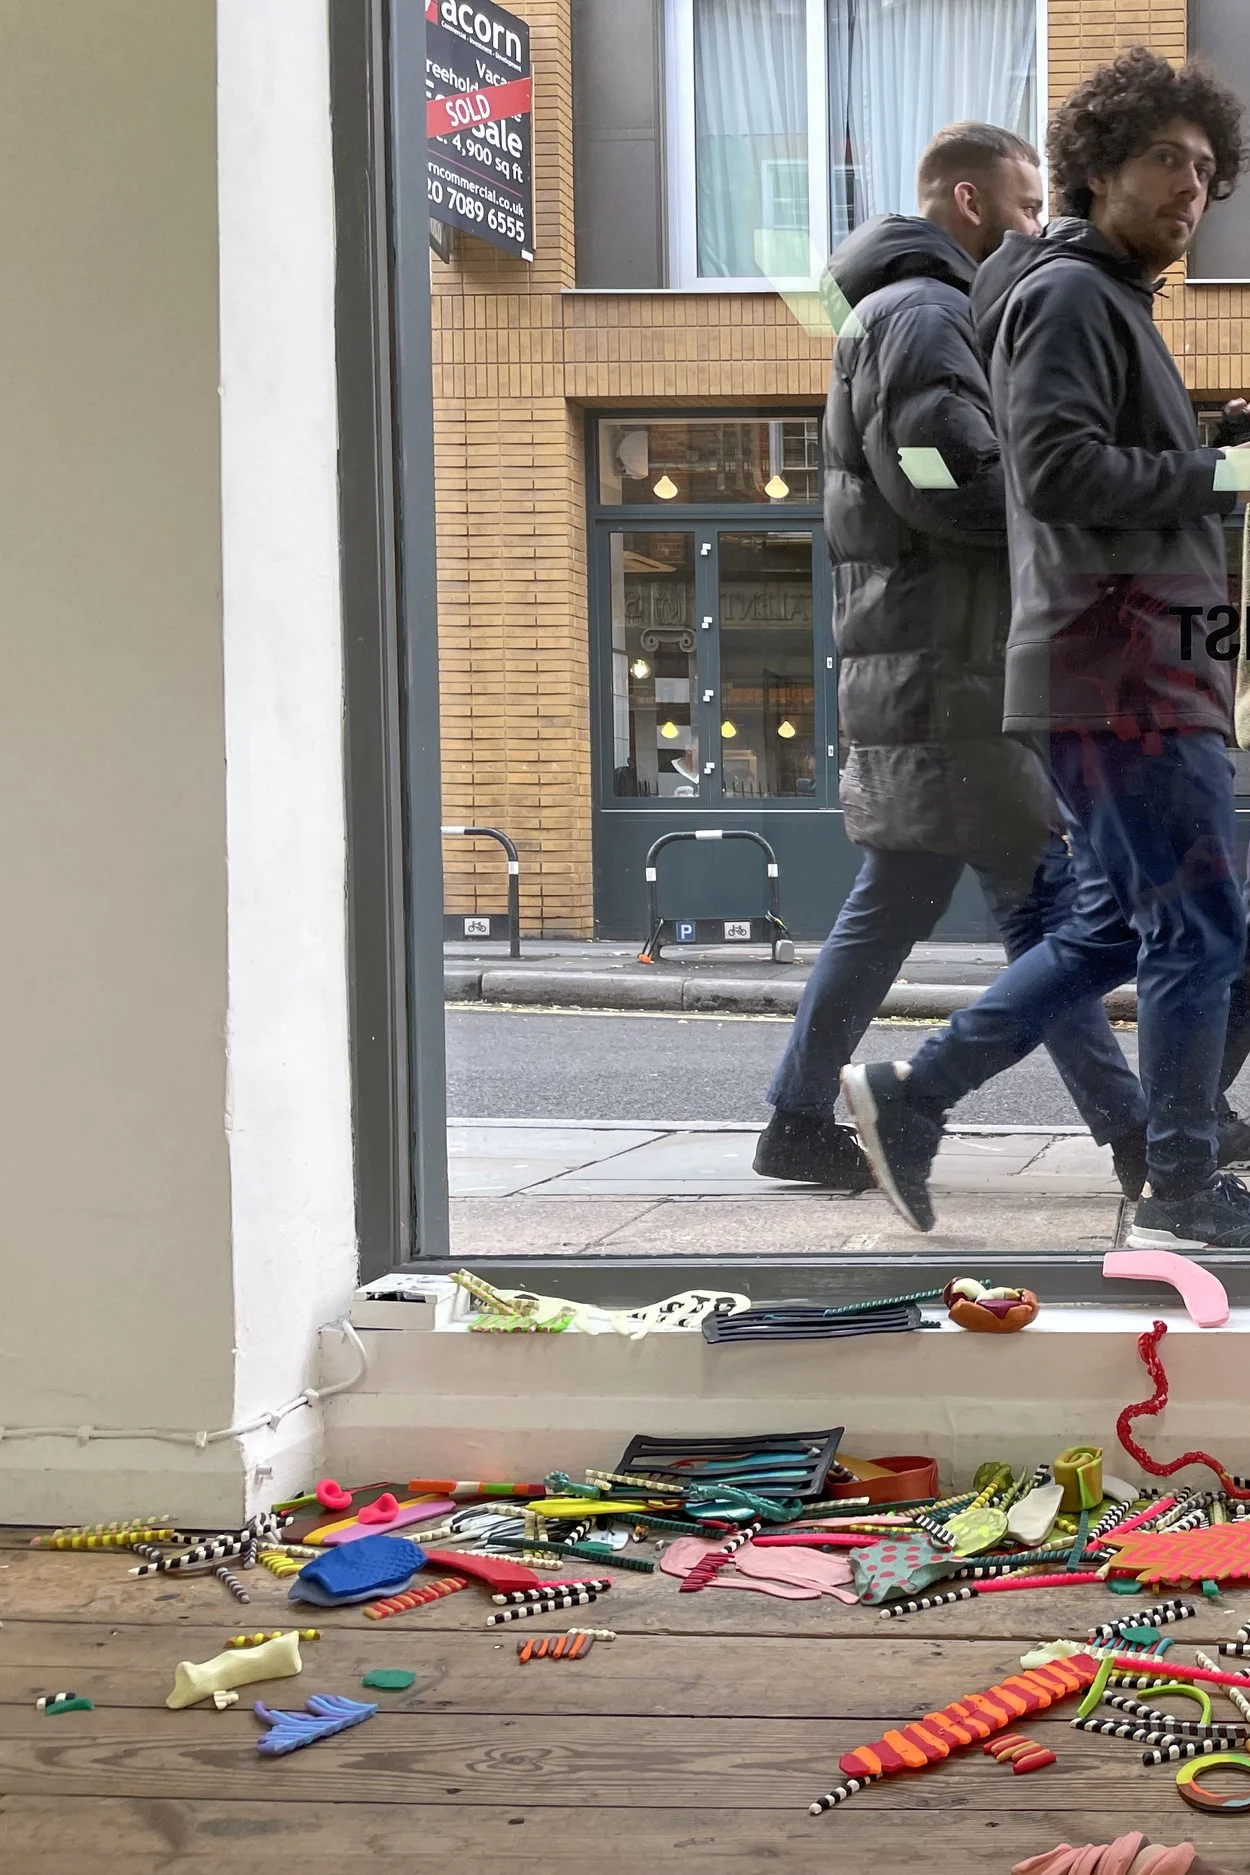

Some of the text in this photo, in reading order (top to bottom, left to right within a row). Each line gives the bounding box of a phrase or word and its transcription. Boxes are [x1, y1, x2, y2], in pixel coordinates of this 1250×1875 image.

[441, 0, 521, 63] acorn
[445, 94, 490, 127] SOLD
[452, 133, 523, 183] 4,900 sq ft
[428, 162, 524, 217] rncommercial.co.uk
[447, 187, 484, 222] 7089
[488, 208, 525, 242] 6555
[680, 924, 693, 940] P
